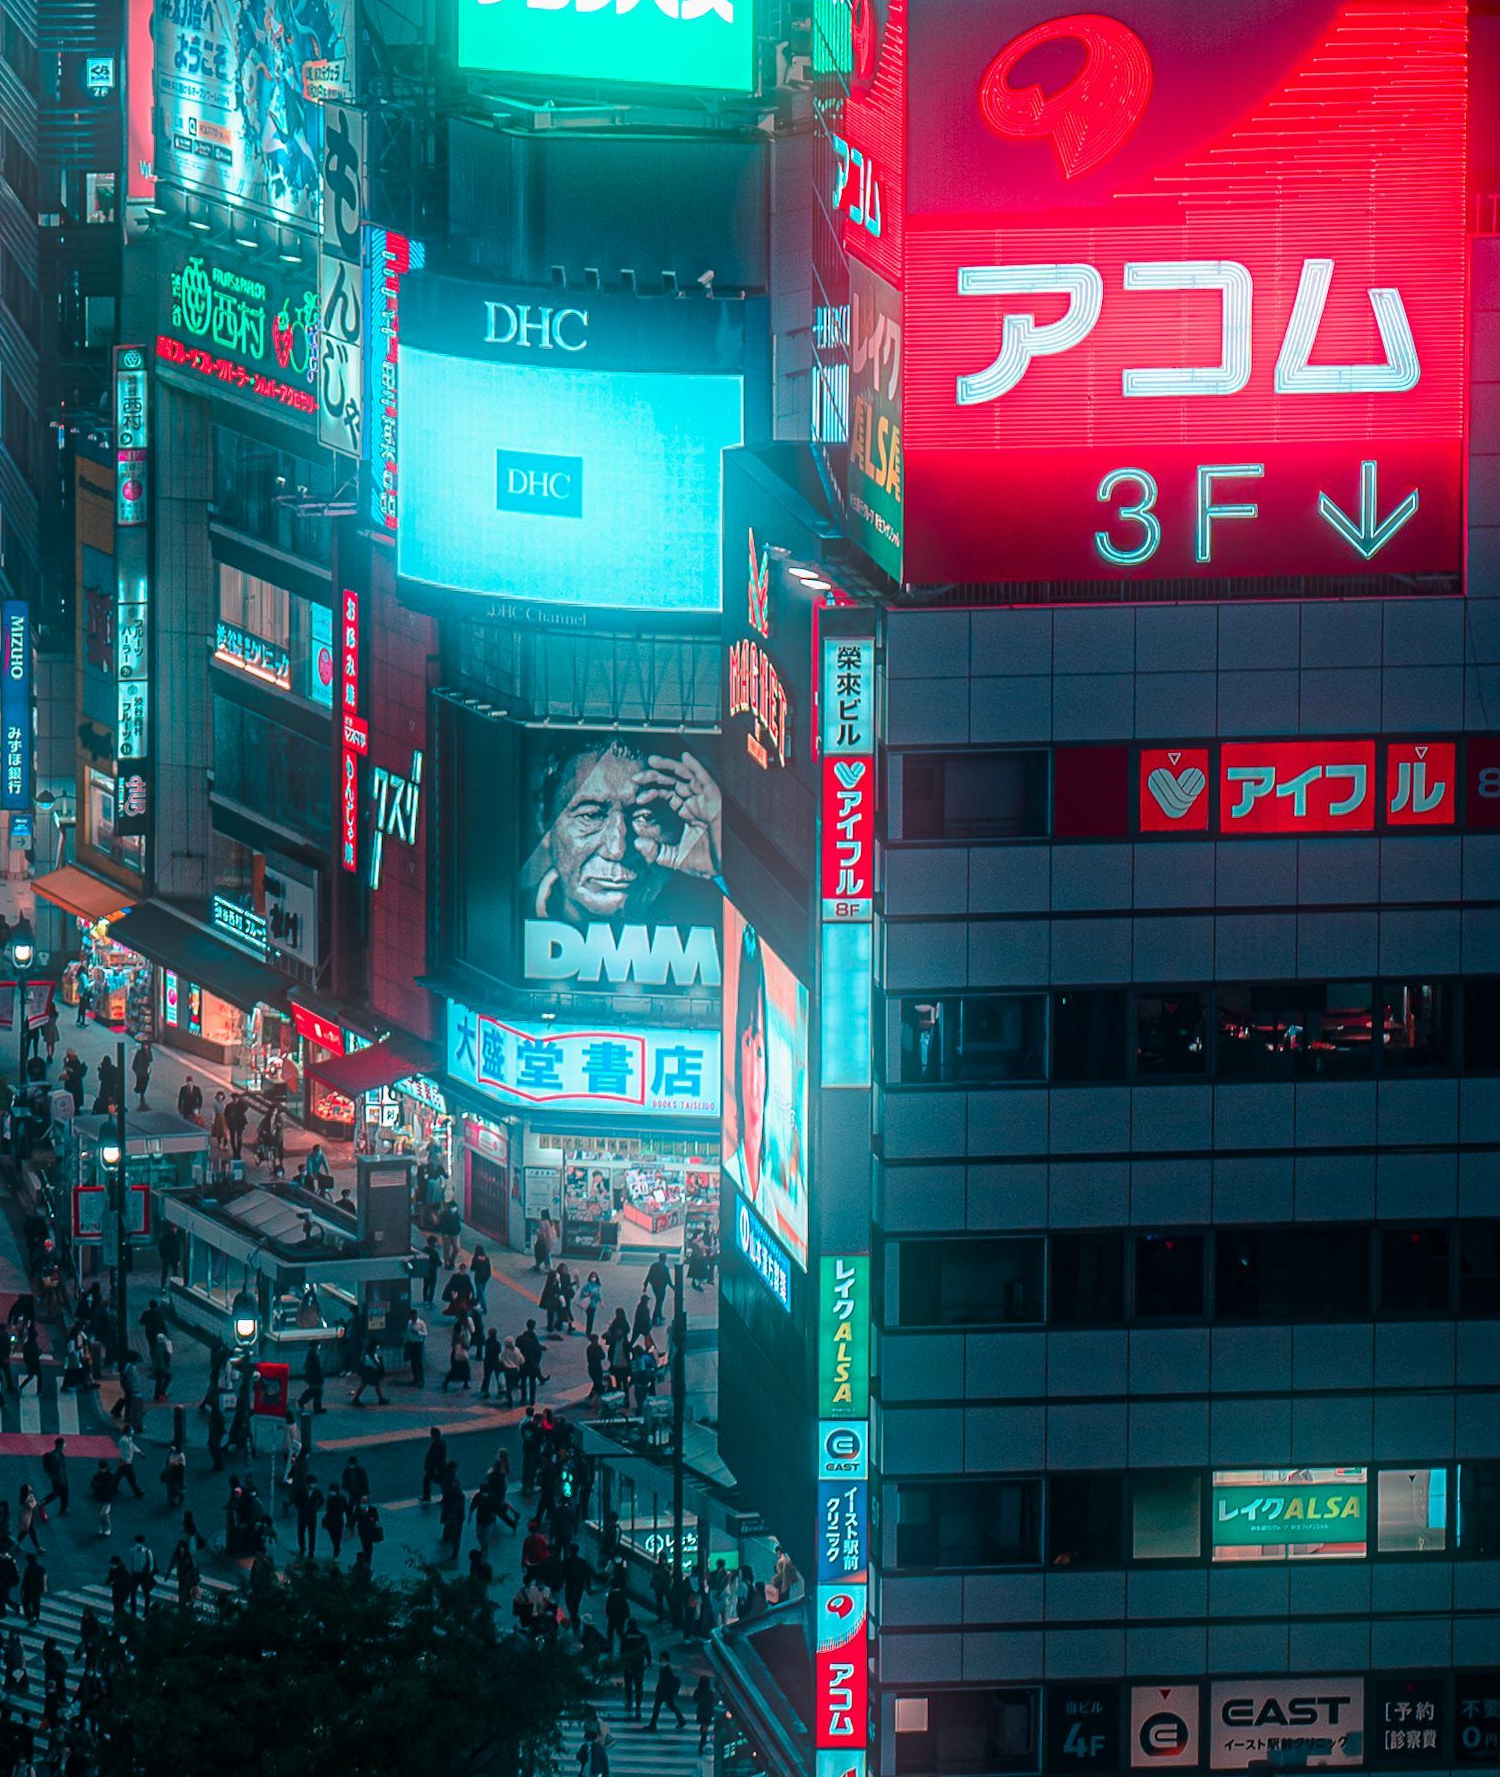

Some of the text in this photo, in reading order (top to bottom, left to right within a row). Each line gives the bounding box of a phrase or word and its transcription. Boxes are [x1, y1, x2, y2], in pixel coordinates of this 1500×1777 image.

[831, 132, 881, 238] アコム
[212, 290, 266, 360] 西村
[485, 300, 589, 351] DHC
[852, 292, 901, 400] レイク
[957, 258, 1422, 406] アコム
[850, 394, 901, 503] ALSA
[506, 468, 573, 500] DHC
[11, 614, 23, 681] MIZUHO
[729, 638, 788, 768] MAGNET
[7, 726, 23, 795] みずほ銀行
[1227, 762, 1500, 820] アイフル 8
[370, 749, 423, 891] クスリ
[835, 790, 865, 895] アイフル
[835, 902, 861, 917] 8F
[523, 918, 721, 988] DMM
[456, 1016, 704, 1098] 大盛堂書店
[652, 1100, 678, 1109] BOOKS
[825, 1462, 860, 1471] EAST
[825, 1497, 840, 1563] クリニック
[843, 1486, 859, 1571] イースト駅前
[1219, 1495, 1361, 1522] レイクALSA
[828, 1662, 855, 1737] アコム
[1221, 1696, 1351, 1726] EAST
[1062, 1723, 1105, 1758] 4F
